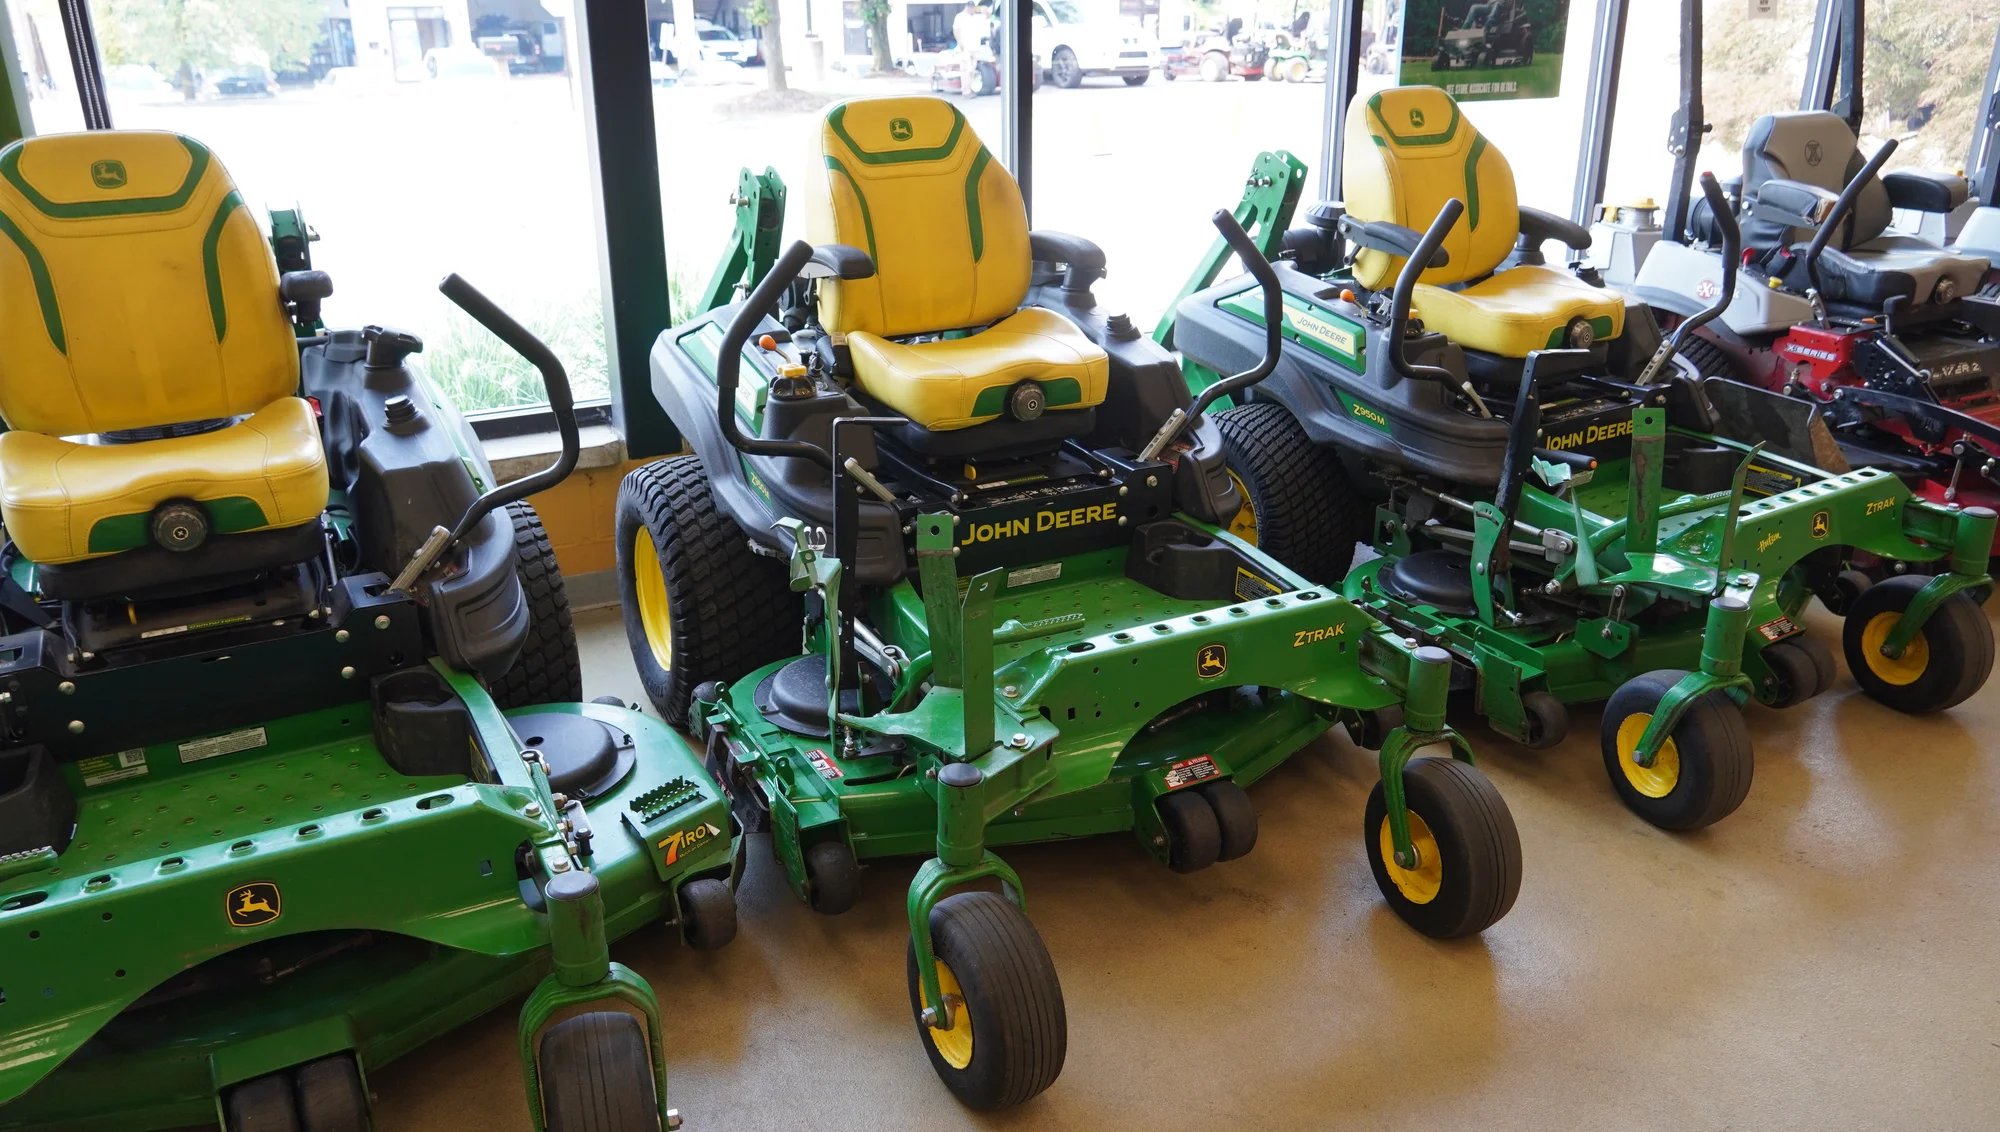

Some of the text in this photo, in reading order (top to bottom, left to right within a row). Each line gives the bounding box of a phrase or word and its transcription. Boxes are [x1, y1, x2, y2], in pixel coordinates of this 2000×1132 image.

[1297, 316, 1347, 345] JOHN DEERE
[1352, 403, 1385, 426] Z950M
[1586, 420, 1633, 444] DEERE
[1865, 496, 1896, 516] ZTRAK
[961, 502, 1117, 546] JOHN DEERE
[1757, 531, 1782, 553] Hutson
[1293, 622, 1346, 648] ZTRAK
